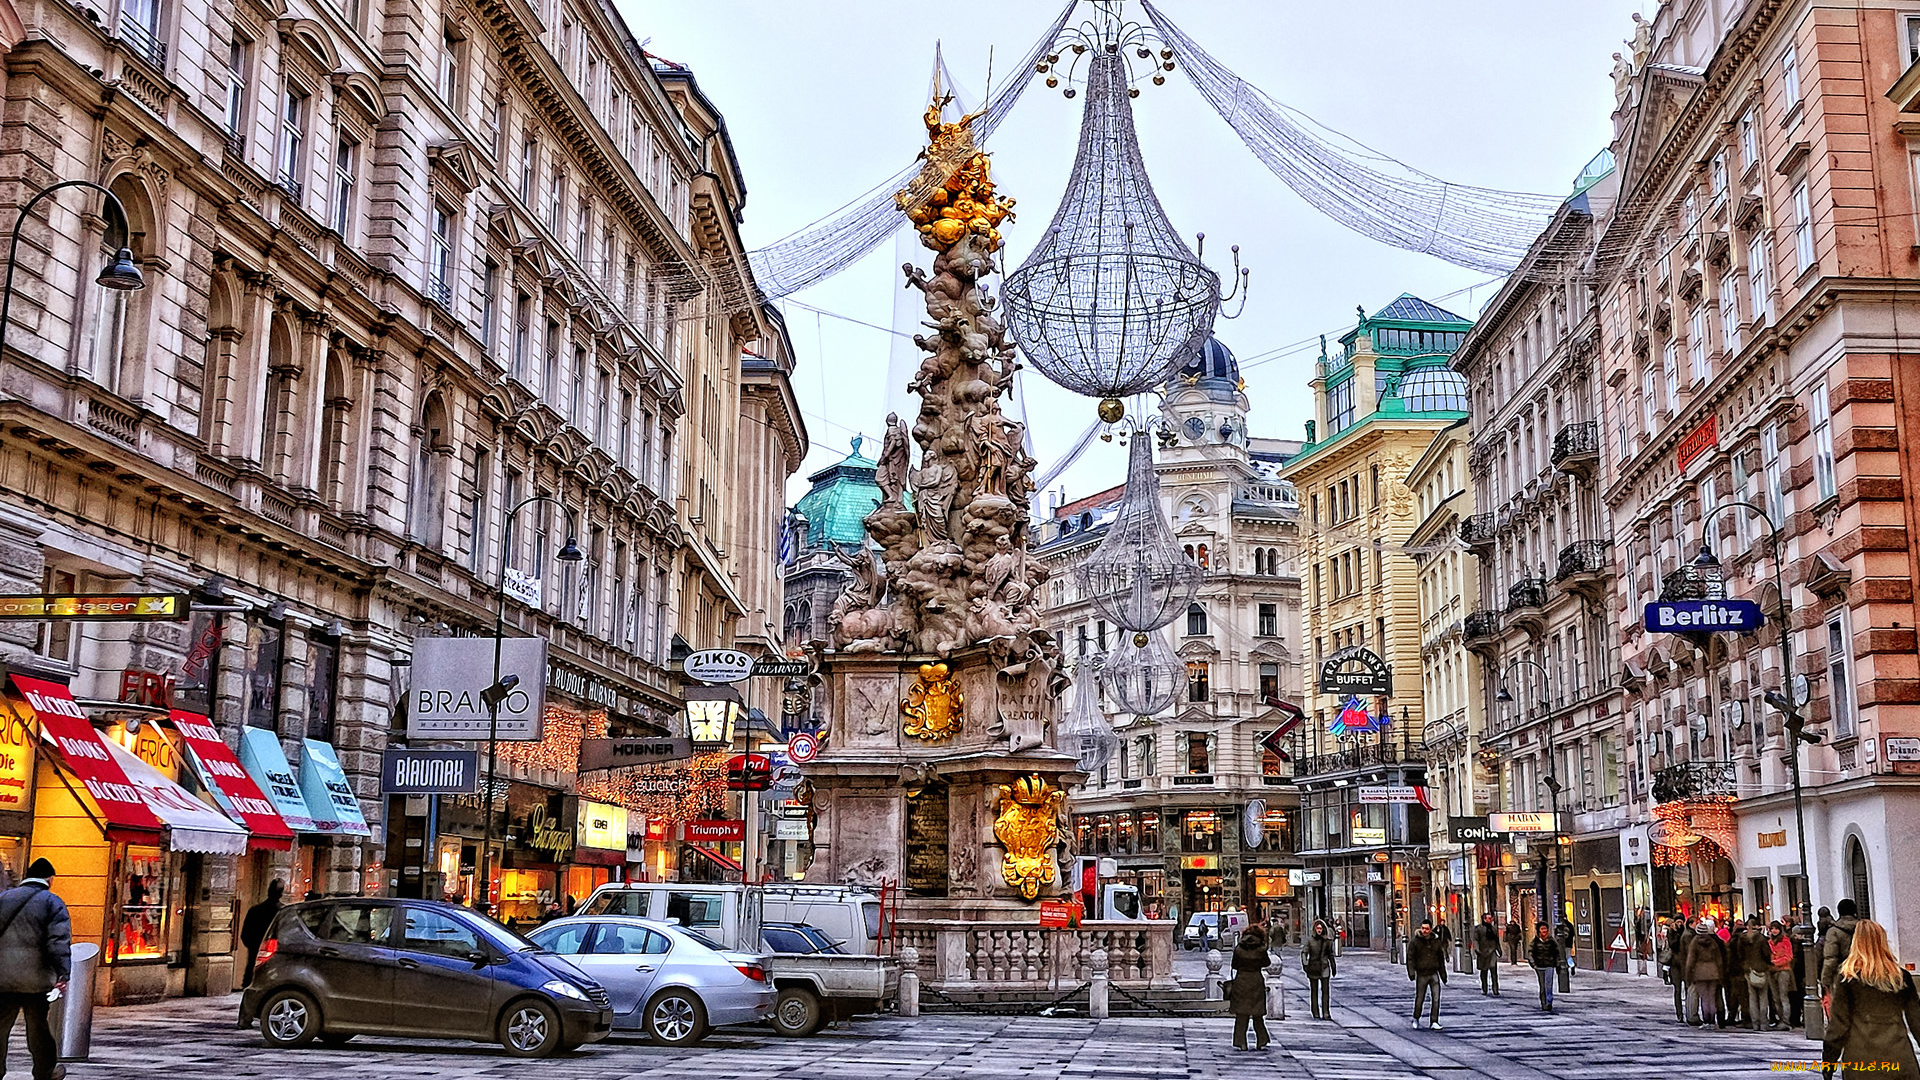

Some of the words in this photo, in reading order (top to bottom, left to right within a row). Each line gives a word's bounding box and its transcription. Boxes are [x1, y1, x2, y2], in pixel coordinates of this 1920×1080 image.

[1659, 605, 1743, 626] Berlitz
[182, 619, 228, 679] FRICK
[692, 653, 747, 668] ZIKOS
[1336, 675, 1374, 685] BUFFET
[588, 674, 617, 708] HÜBNER
[58, 736, 109, 761] BOOKS
[613, 744, 674, 756] HÜBNER
[204, 758, 246, 779] BOOKS
[1508, 814, 1541, 822] HABAN
[690, 825, 731, 837] Triumph
